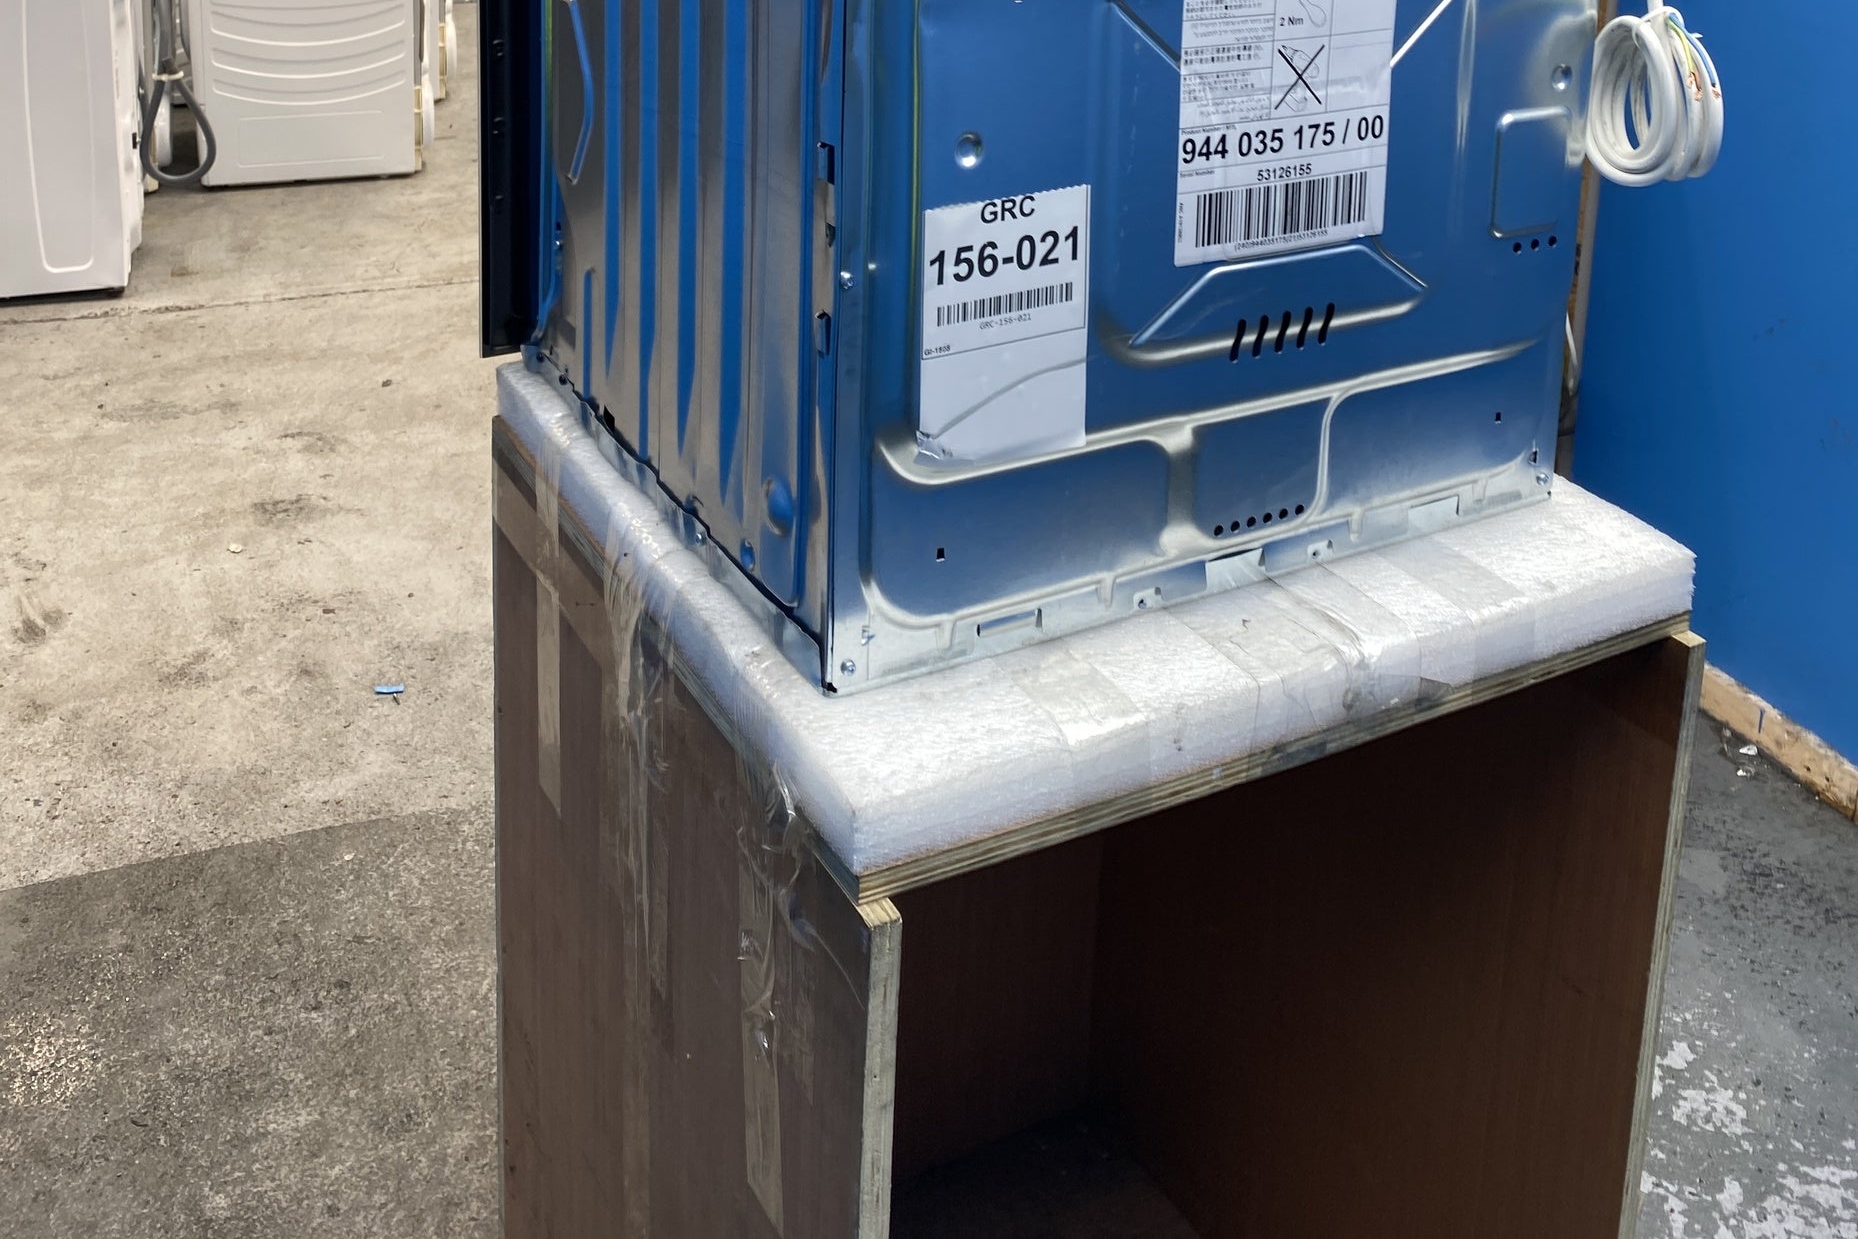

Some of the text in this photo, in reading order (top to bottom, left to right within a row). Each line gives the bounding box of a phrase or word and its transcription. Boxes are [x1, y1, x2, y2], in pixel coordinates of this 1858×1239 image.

[1279, 17, 1304, 27] 2 Nm
[1182, 115, 1384, 164] 944 035 175 / 00
[1256, 162, 1313, 182] 53126155
[980, 195, 1036, 224] GRC
[929, 225, 1079, 286] 156-021
